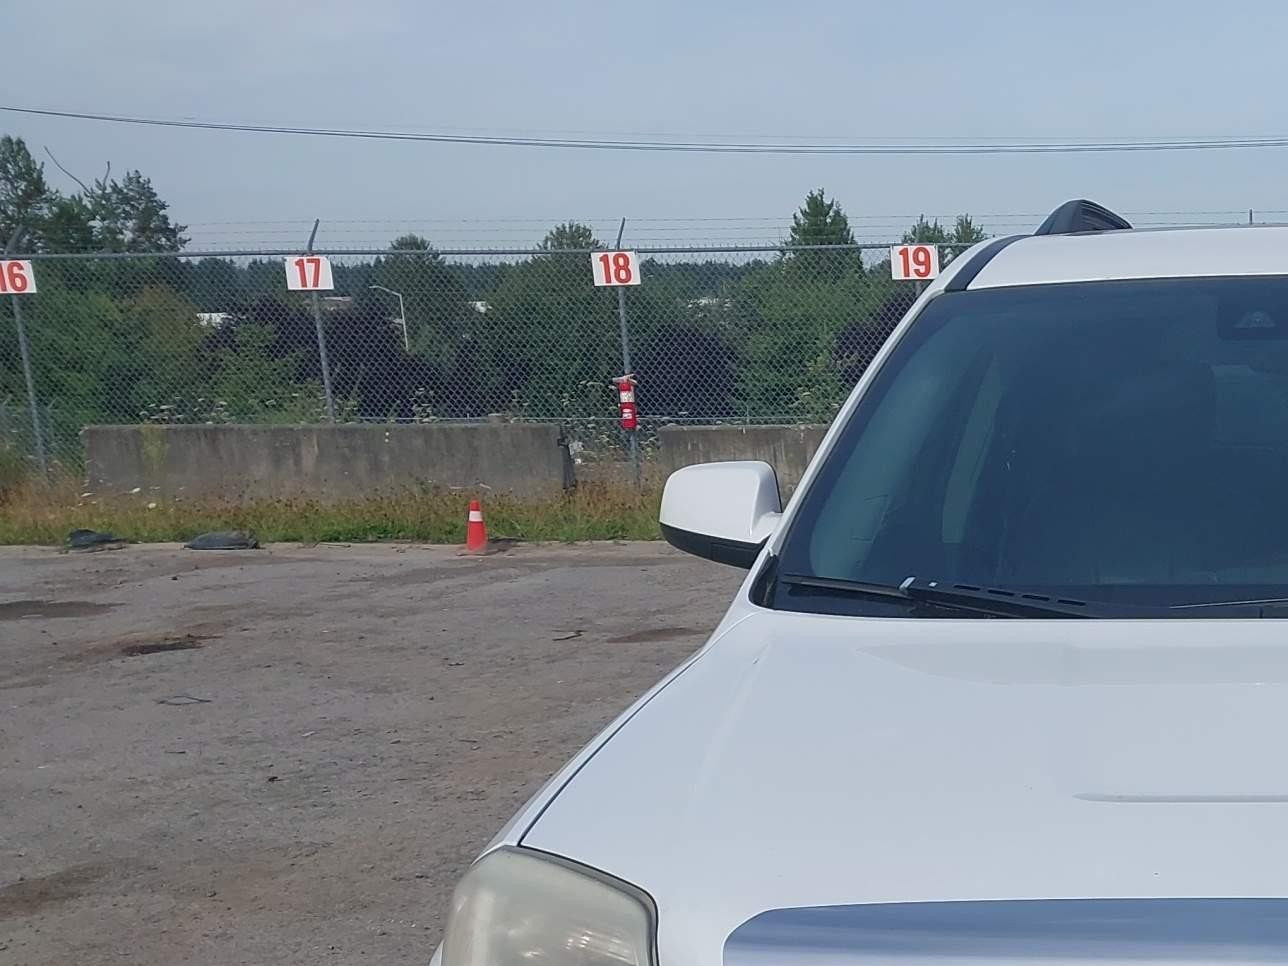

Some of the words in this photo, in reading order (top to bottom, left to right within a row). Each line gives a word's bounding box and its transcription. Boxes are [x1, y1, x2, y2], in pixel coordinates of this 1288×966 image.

[0, 261, 27, 292] 16
[295, 257, 321, 288] 17
[600, 253, 632, 284] 18
[899, 247, 932, 279] 19
